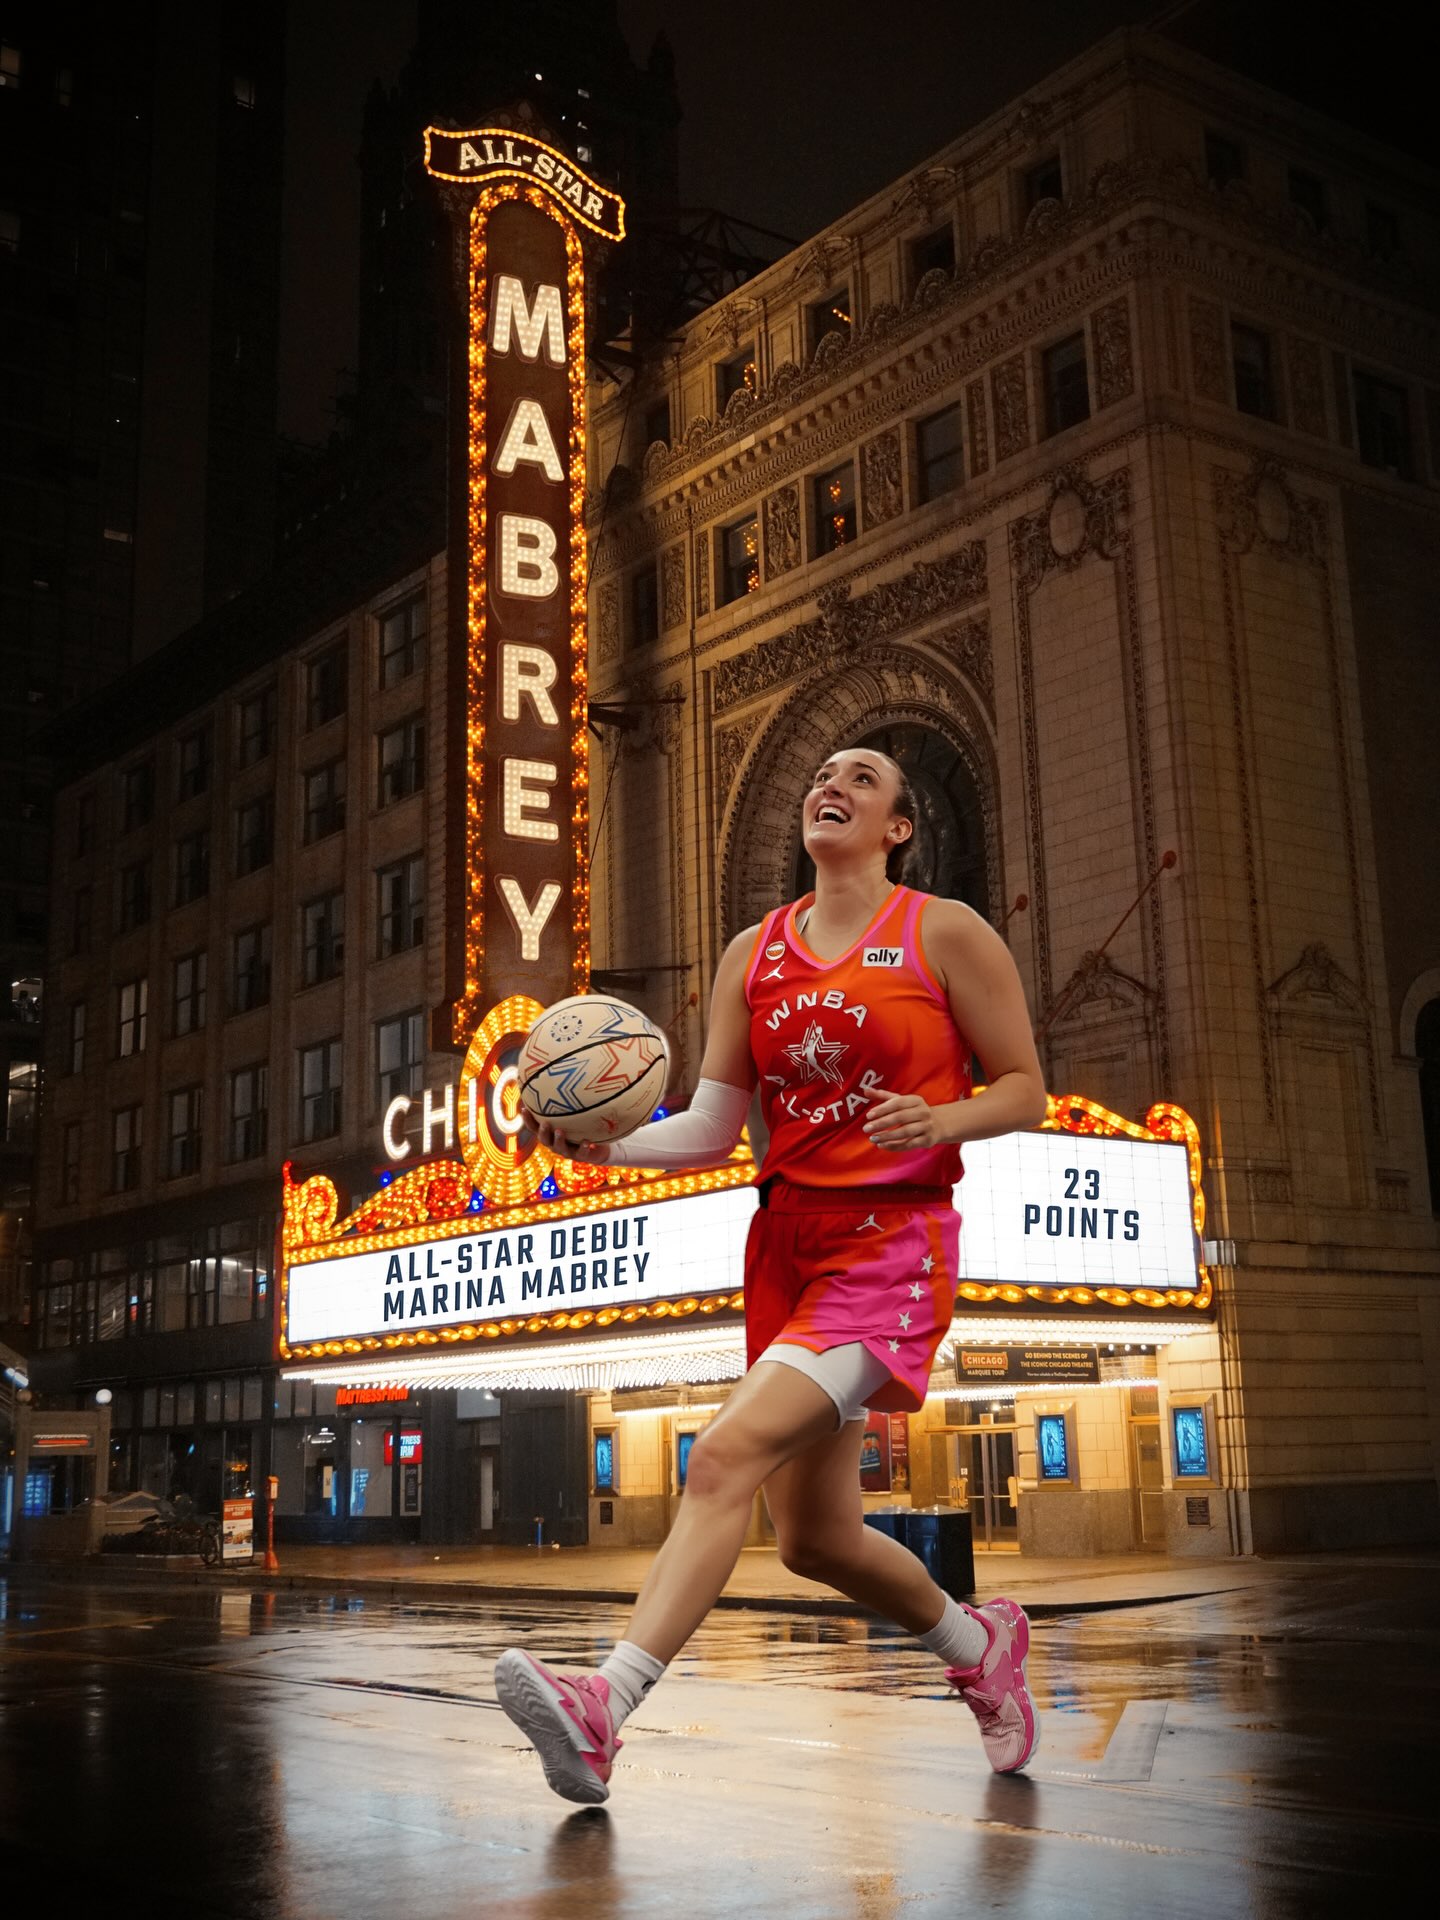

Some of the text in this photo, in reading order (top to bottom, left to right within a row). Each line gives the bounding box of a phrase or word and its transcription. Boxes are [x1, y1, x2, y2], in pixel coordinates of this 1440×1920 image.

[458, 139, 603, 220] ALL-STAR
[493, 275, 566, 961] MABREY
[866, 947, 898, 965] ally
[765, 989, 868, 1031] WNBA
[383, 1064, 525, 1161] CHIC
[1064, 1168, 1100, 1200] 23
[1024, 1204, 1140, 1241] POINTS
[385, 1215, 649, 1285] ALL-STAR DEBUT
[383, 1252, 651, 1322] MARINA MABREY
[967, 1356, 1003, 1365] CHICAGO
[388, 1435, 421, 1447] TRESS
